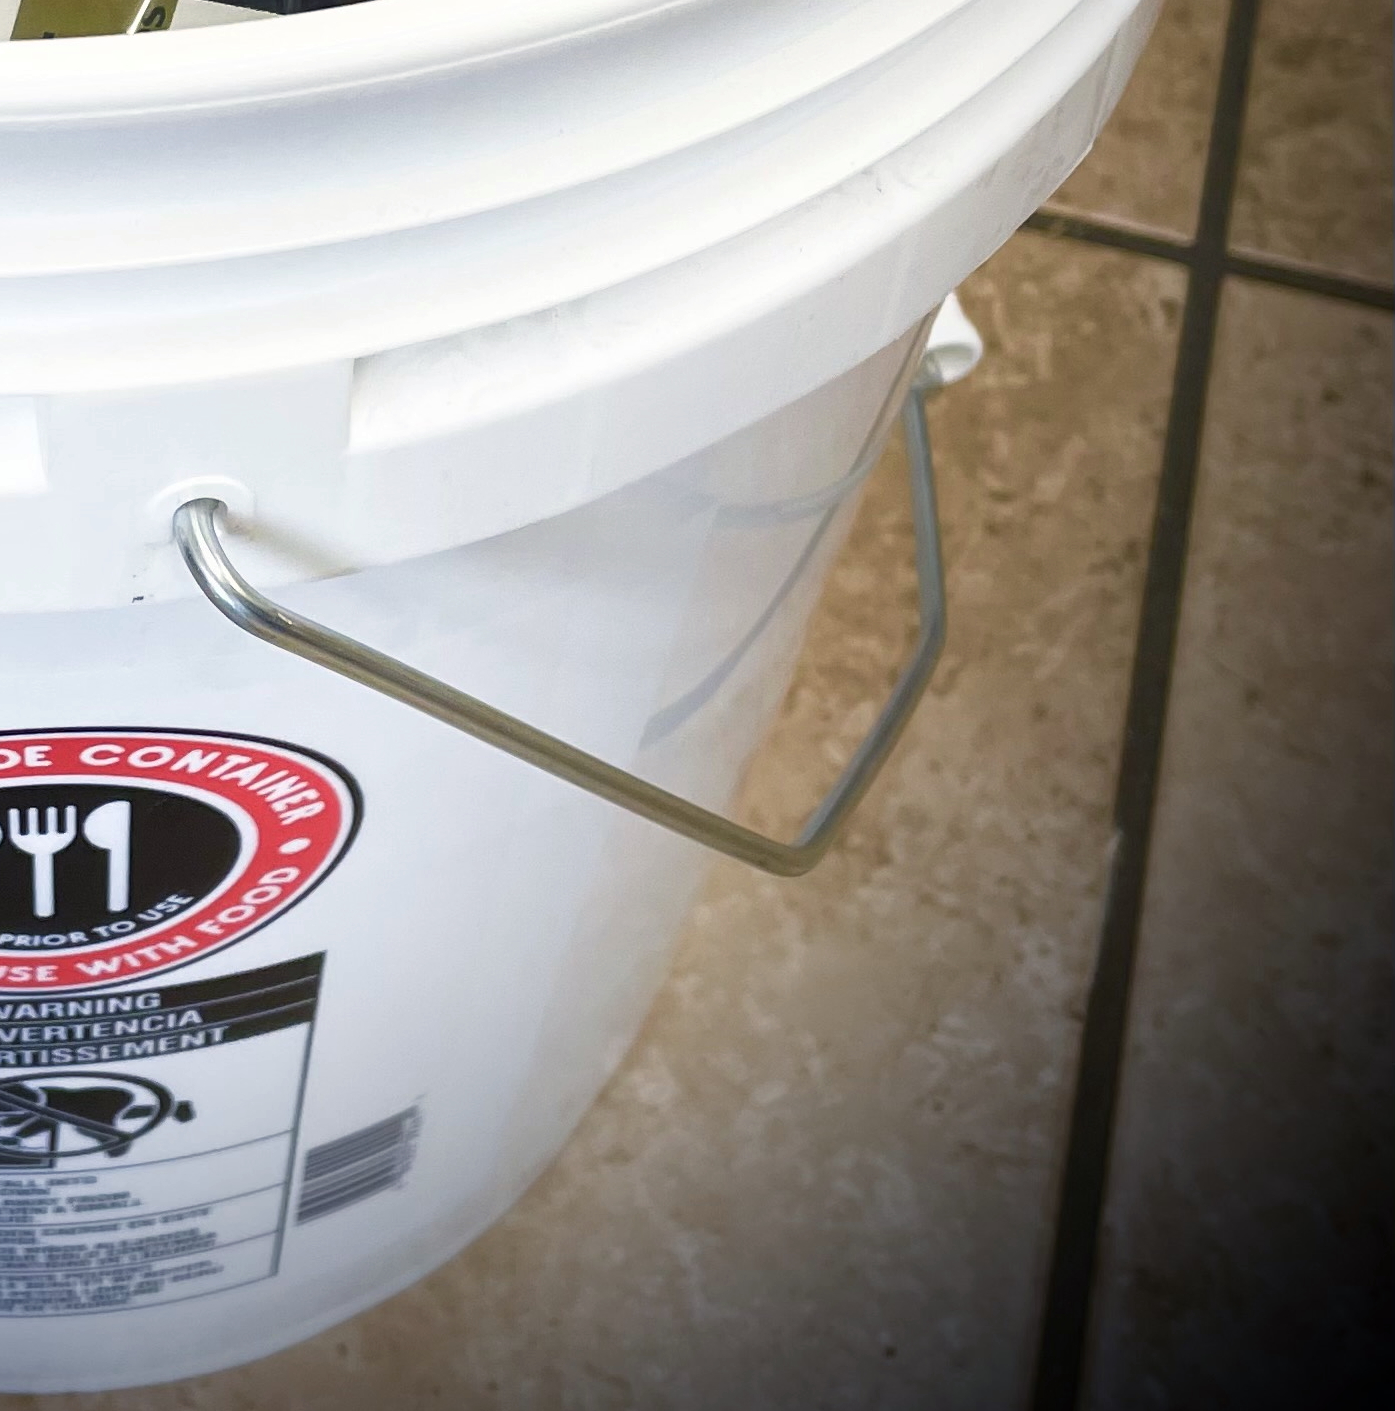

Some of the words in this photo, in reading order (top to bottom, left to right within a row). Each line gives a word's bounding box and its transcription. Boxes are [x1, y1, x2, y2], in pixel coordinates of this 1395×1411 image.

[79, 744, 325, 826] CONTAINER
[74, 935, 198, 977] WITH
[195, 867, 301, 935] FOOD
[92, 921, 136, 938] TO
[137, 894, 195, 922] USE
